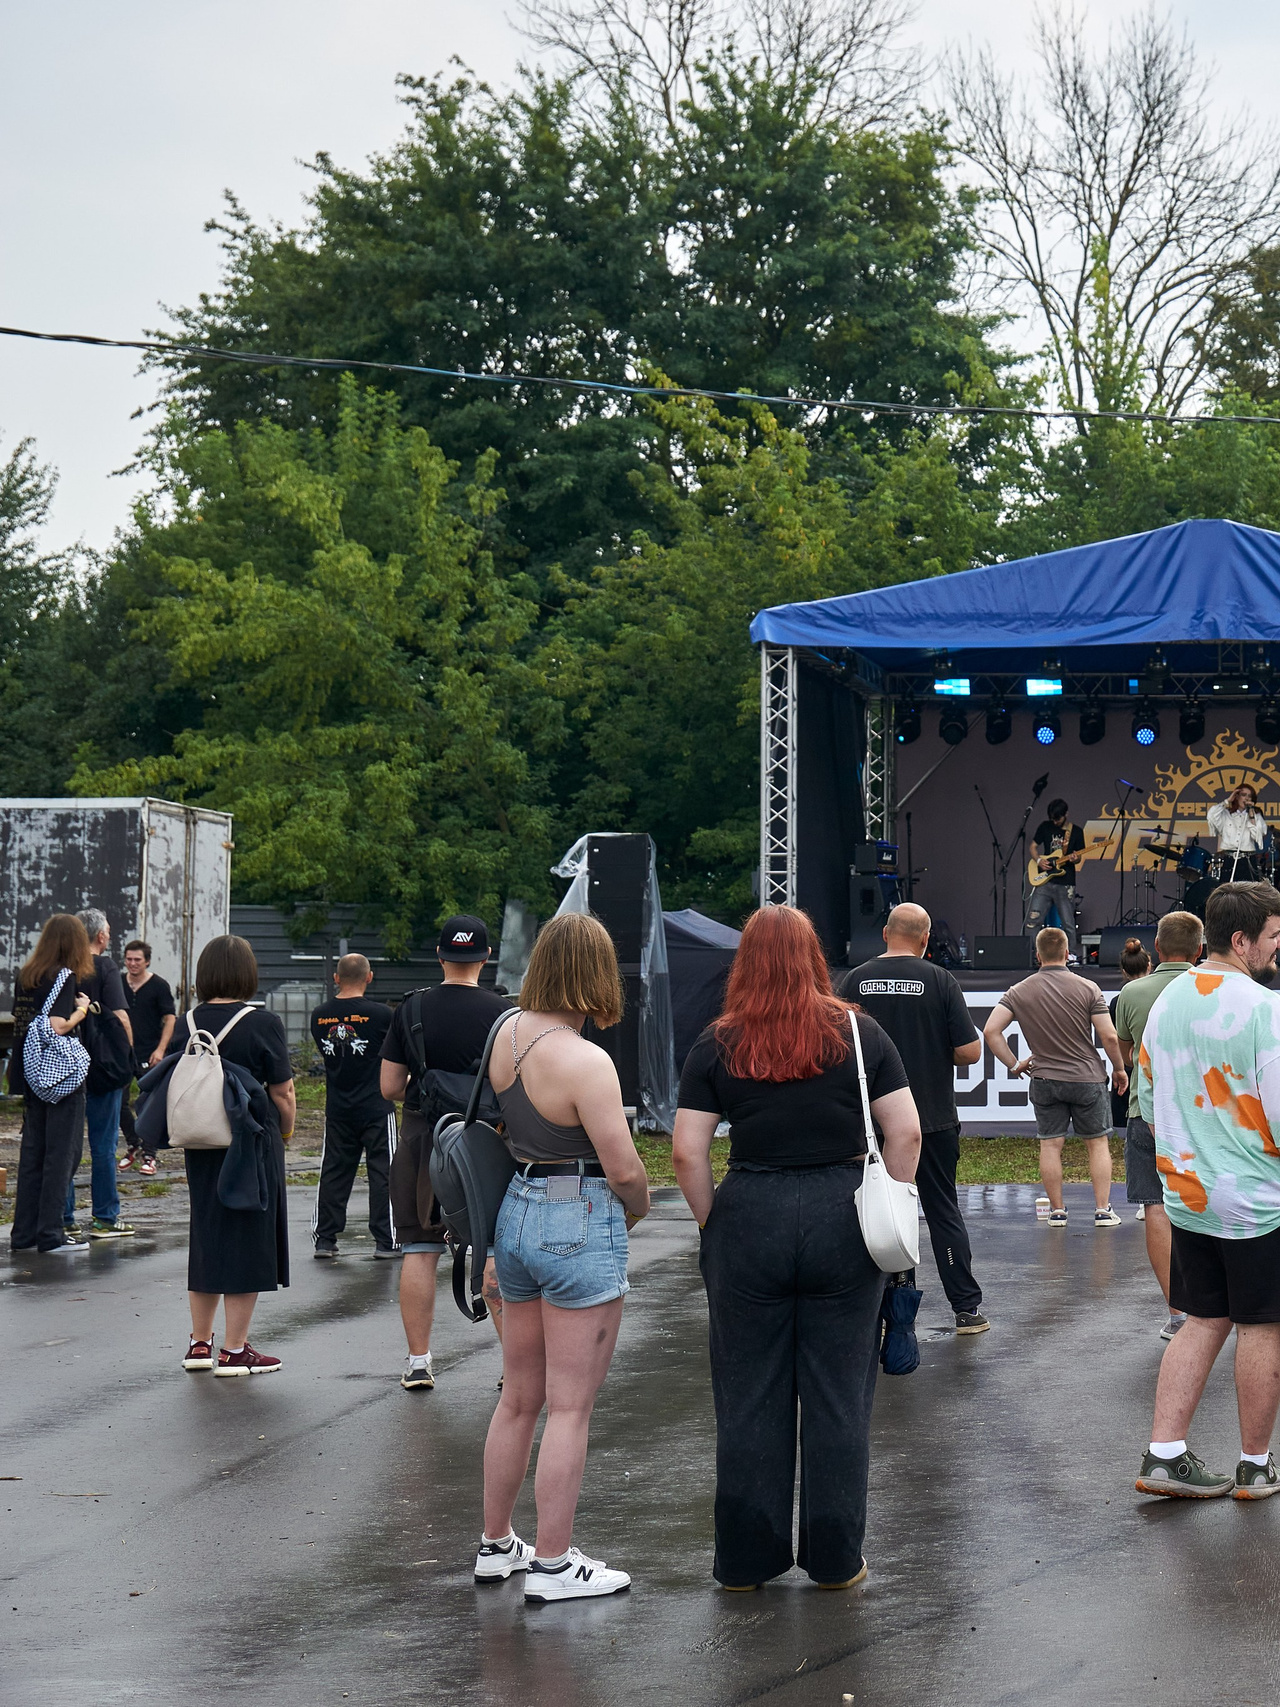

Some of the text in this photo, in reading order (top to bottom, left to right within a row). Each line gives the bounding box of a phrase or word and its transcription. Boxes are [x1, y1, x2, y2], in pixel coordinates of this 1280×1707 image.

[1196, 769, 1270, 798] РОК
[862, 982, 921, 993] ОДЕНЬ СЦЕНУ
